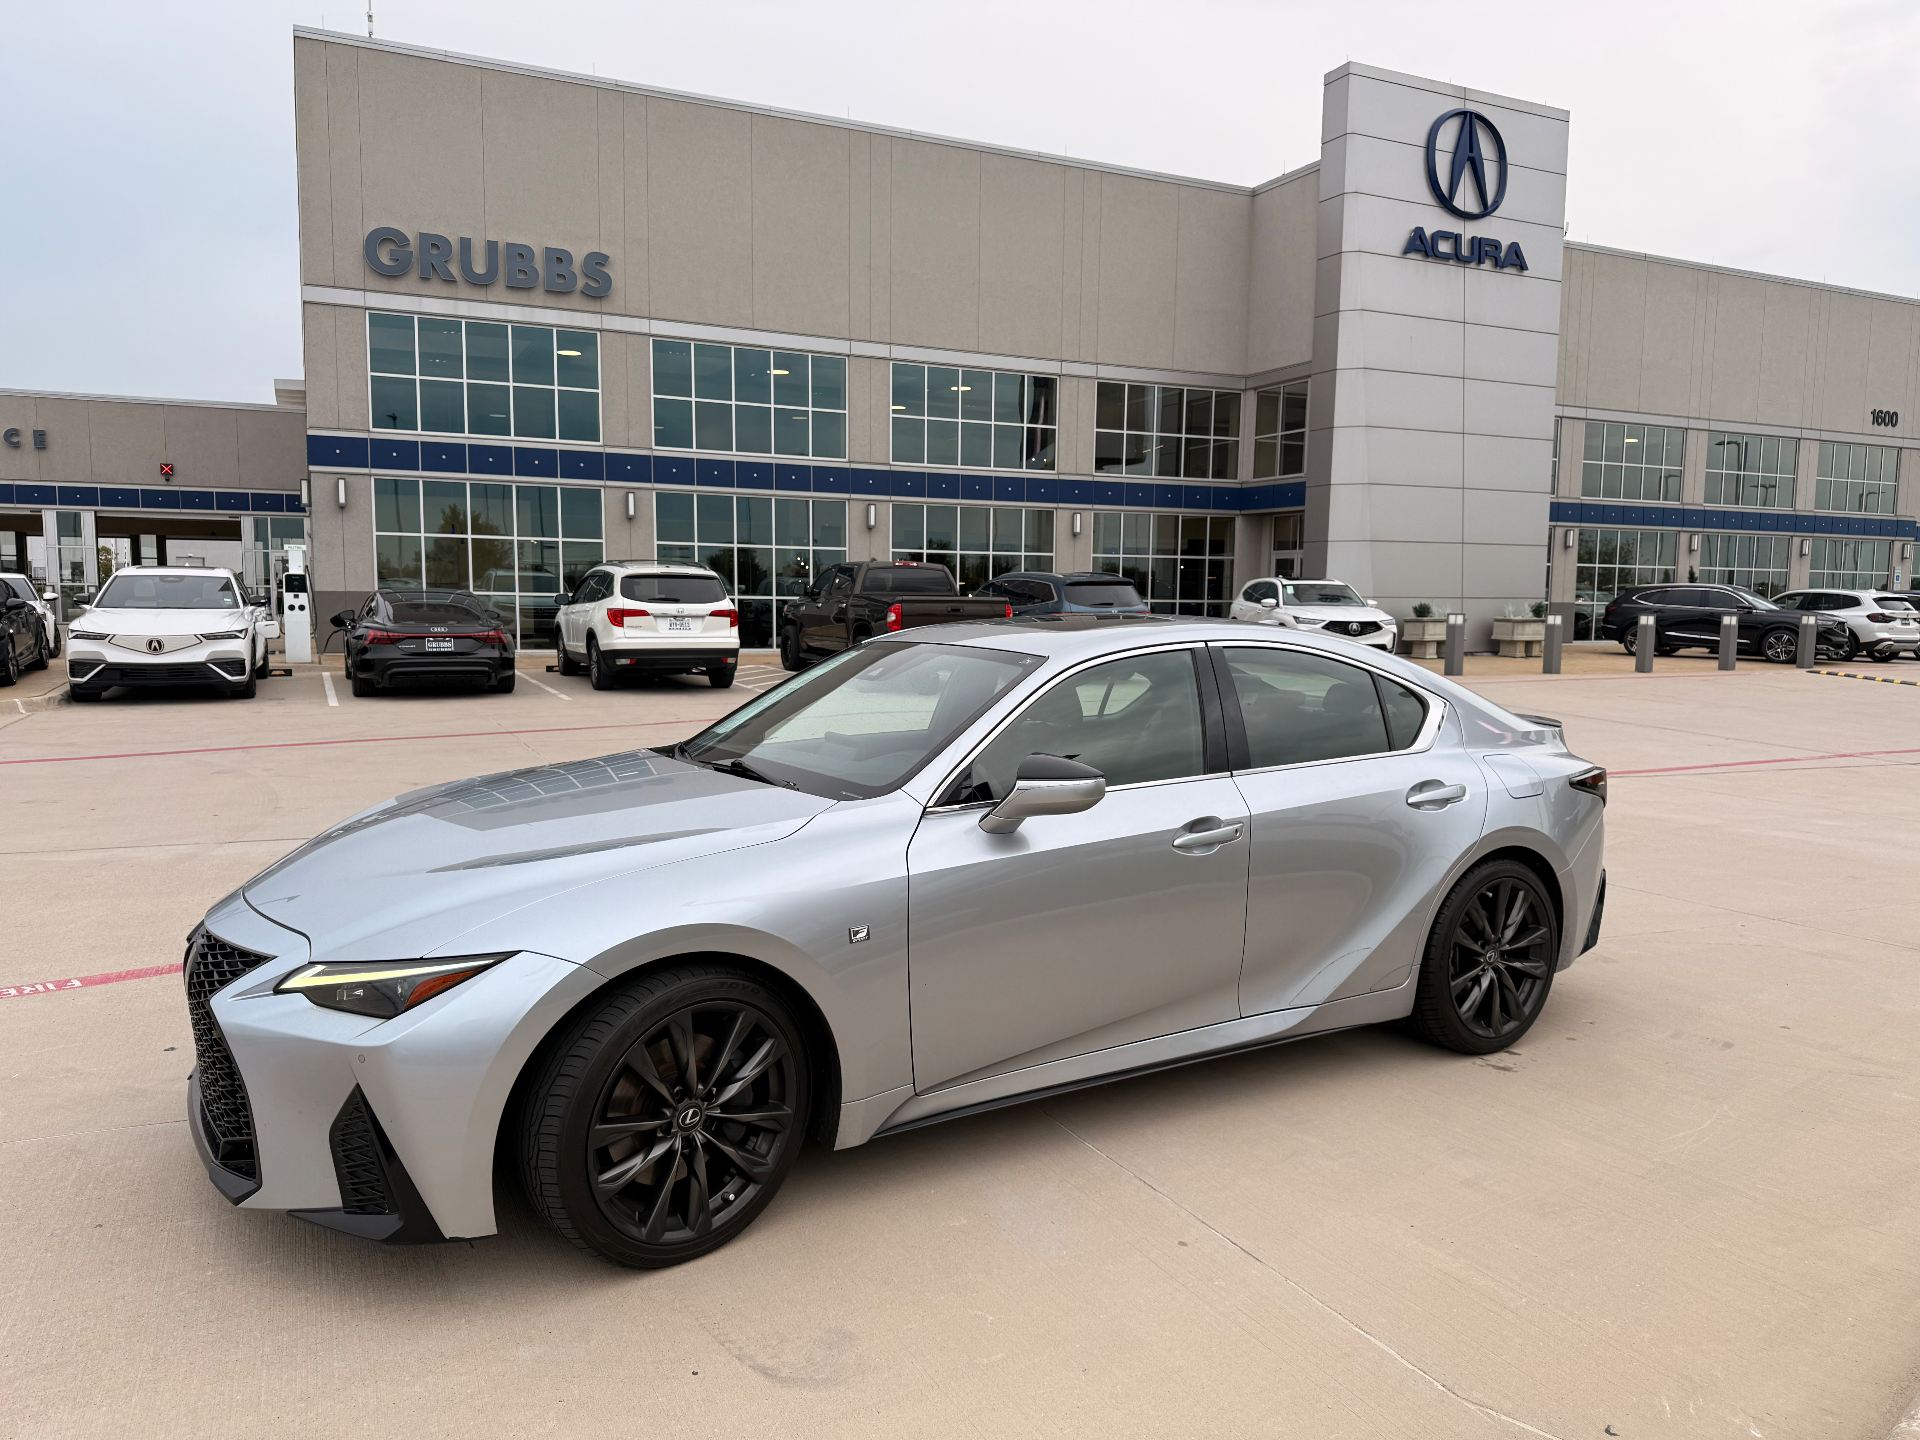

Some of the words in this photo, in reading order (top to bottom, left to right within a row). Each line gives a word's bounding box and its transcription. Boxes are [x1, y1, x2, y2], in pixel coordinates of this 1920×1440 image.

[1403, 226, 1529, 271] ACURA
[364, 226, 613, 298] GRUBBS
[1870, 408, 1899, 428] 1600
[0, 979, 83, 998] FIRE
[717, 981, 761, 995] TOYO
